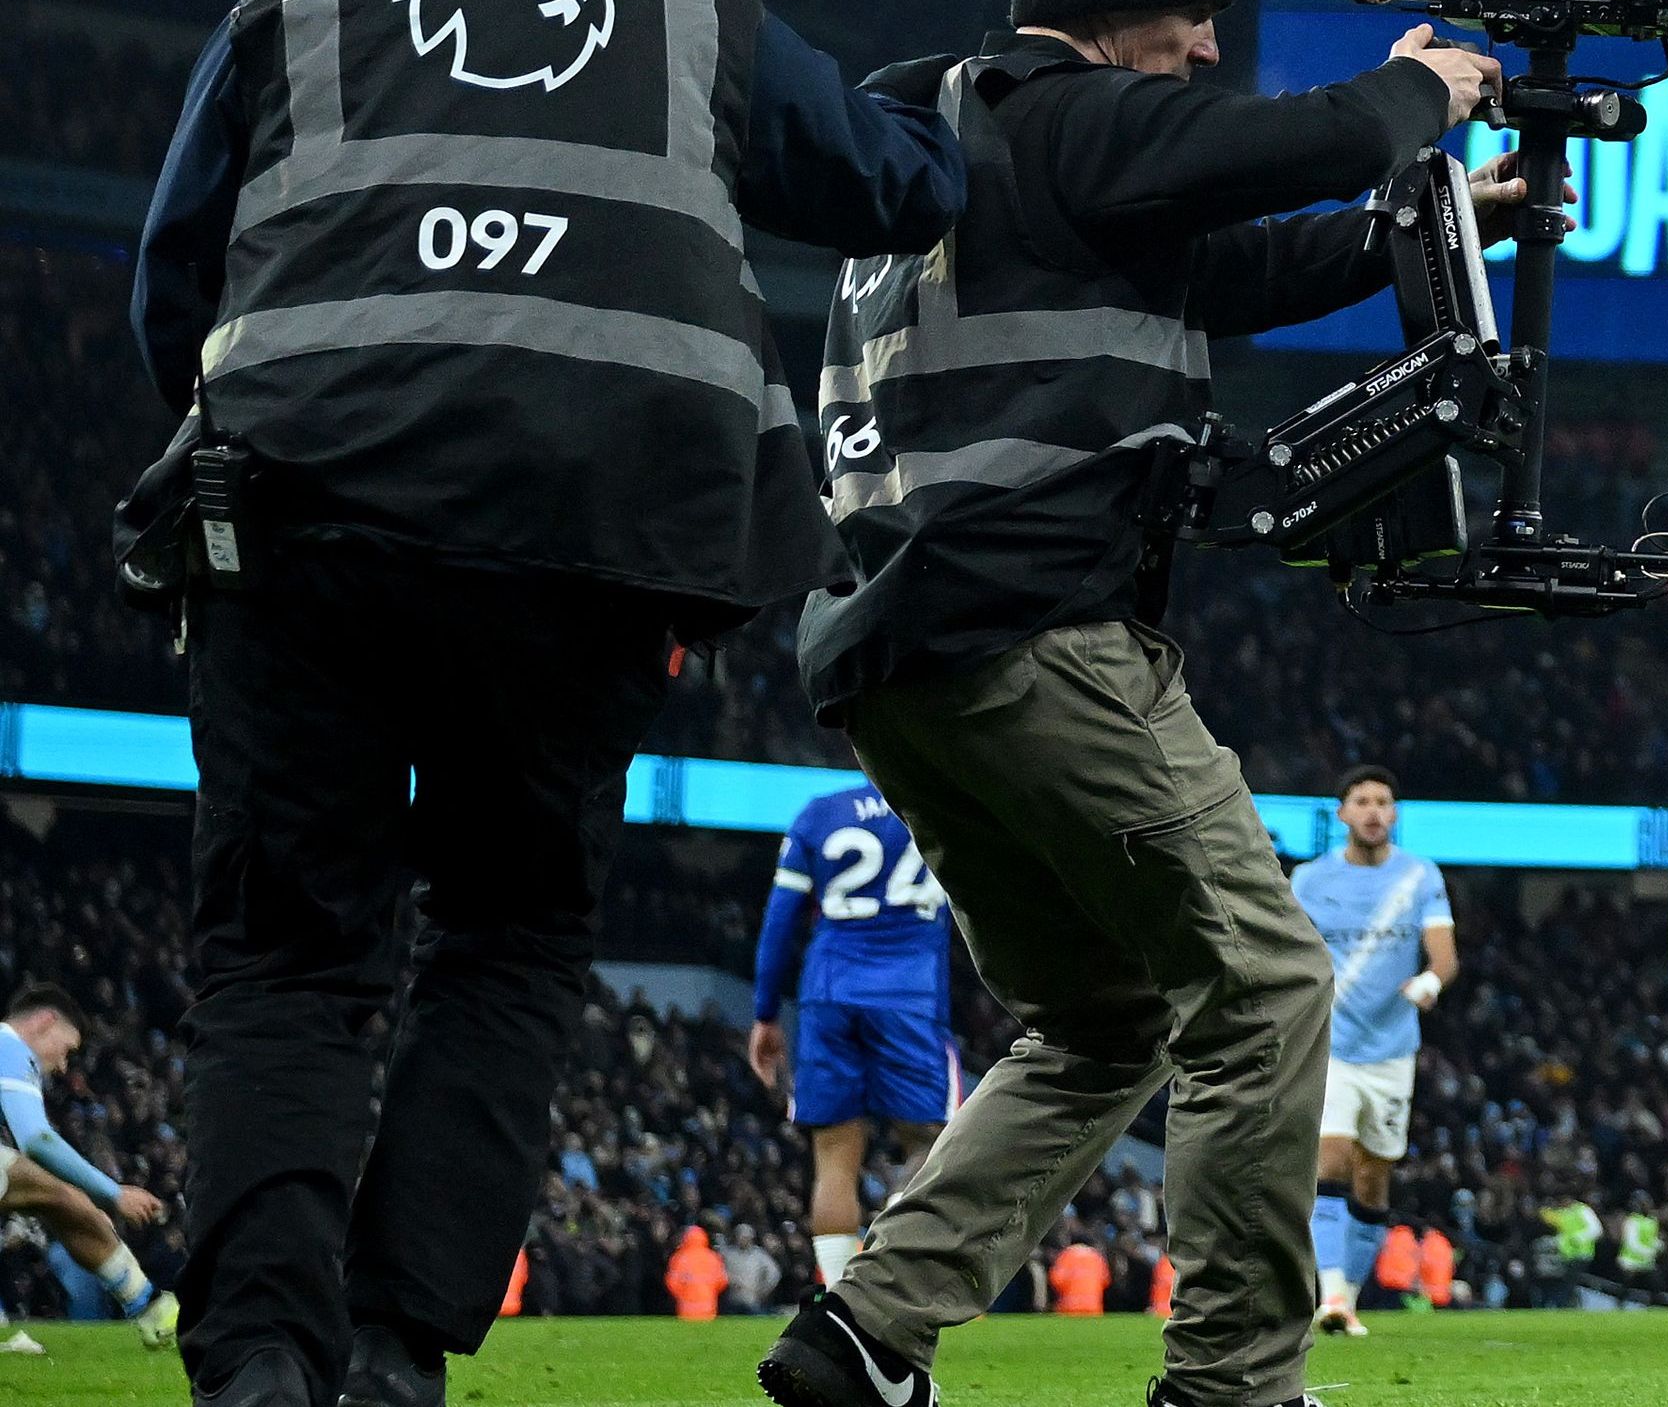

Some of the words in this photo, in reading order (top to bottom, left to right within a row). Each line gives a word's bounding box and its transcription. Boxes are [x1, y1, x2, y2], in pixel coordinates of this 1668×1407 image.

[418, 206, 569, 276] 097
[1439, 185, 1459, 250] STEADICAM
[1365, 352, 1429, 396] STEADICAM
[821, 825, 948, 921] 24
